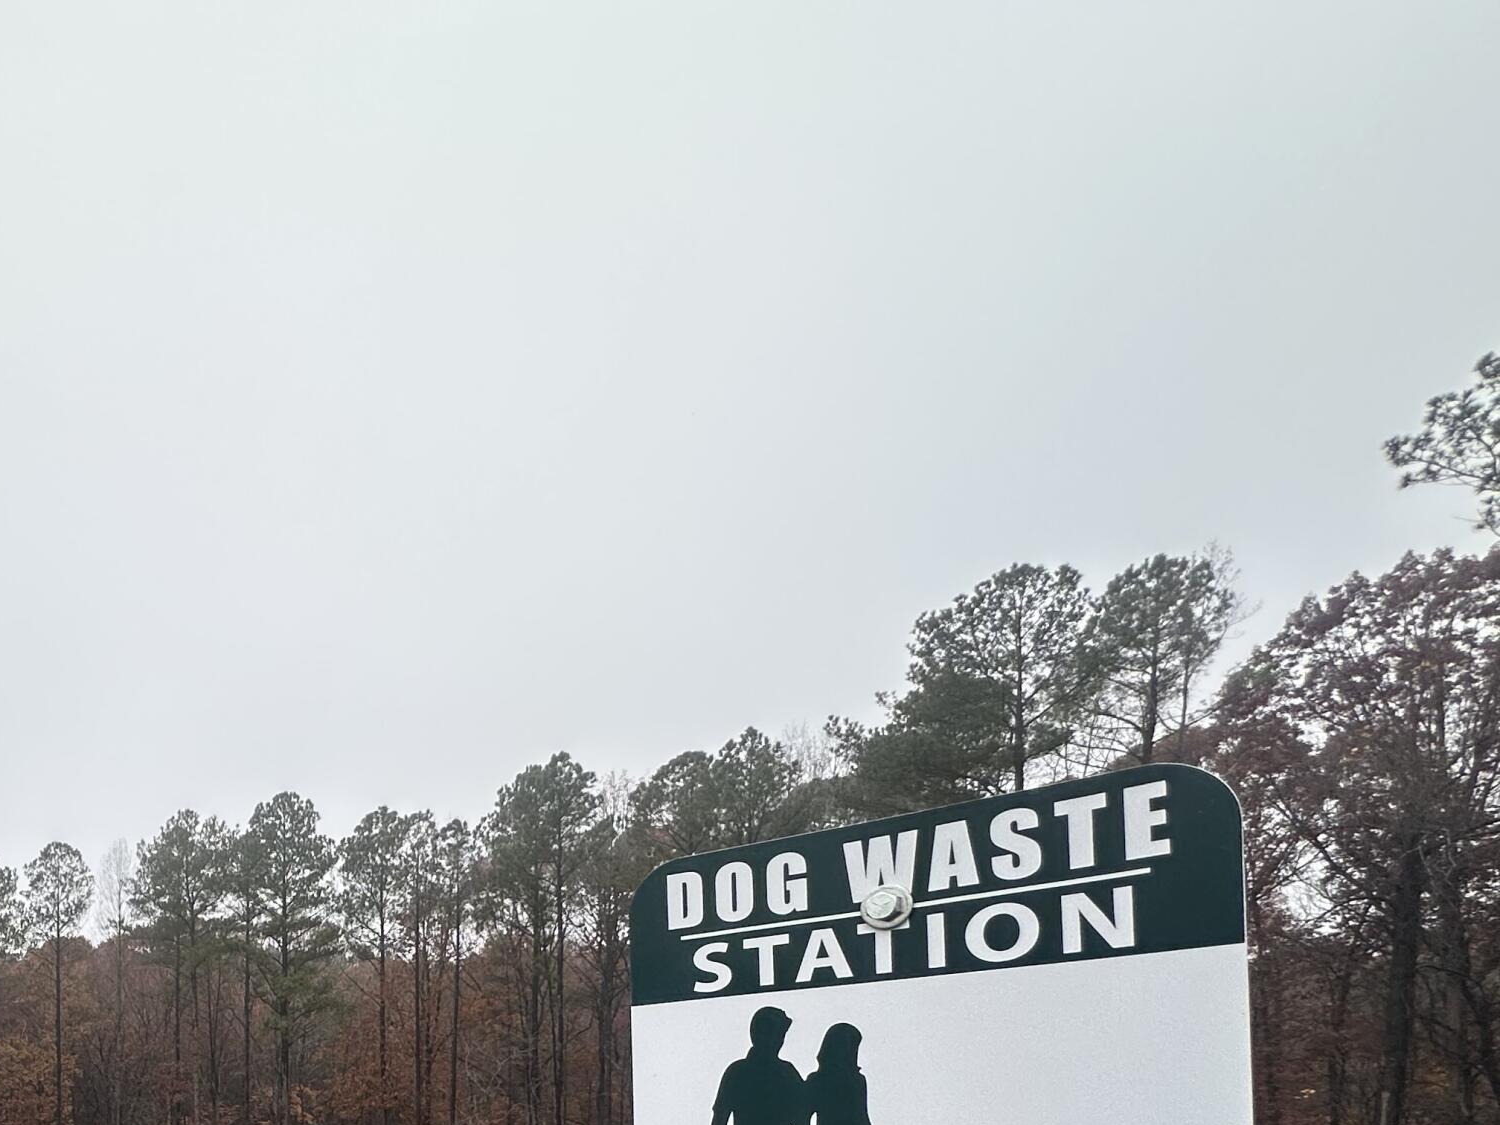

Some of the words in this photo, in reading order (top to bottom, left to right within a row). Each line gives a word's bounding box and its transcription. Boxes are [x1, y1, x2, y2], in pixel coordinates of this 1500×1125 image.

[666, 852, 809, 931] DOG
[843, 779, 1171, 904] WASTE
[693, 885, 1136, 993] STATION
